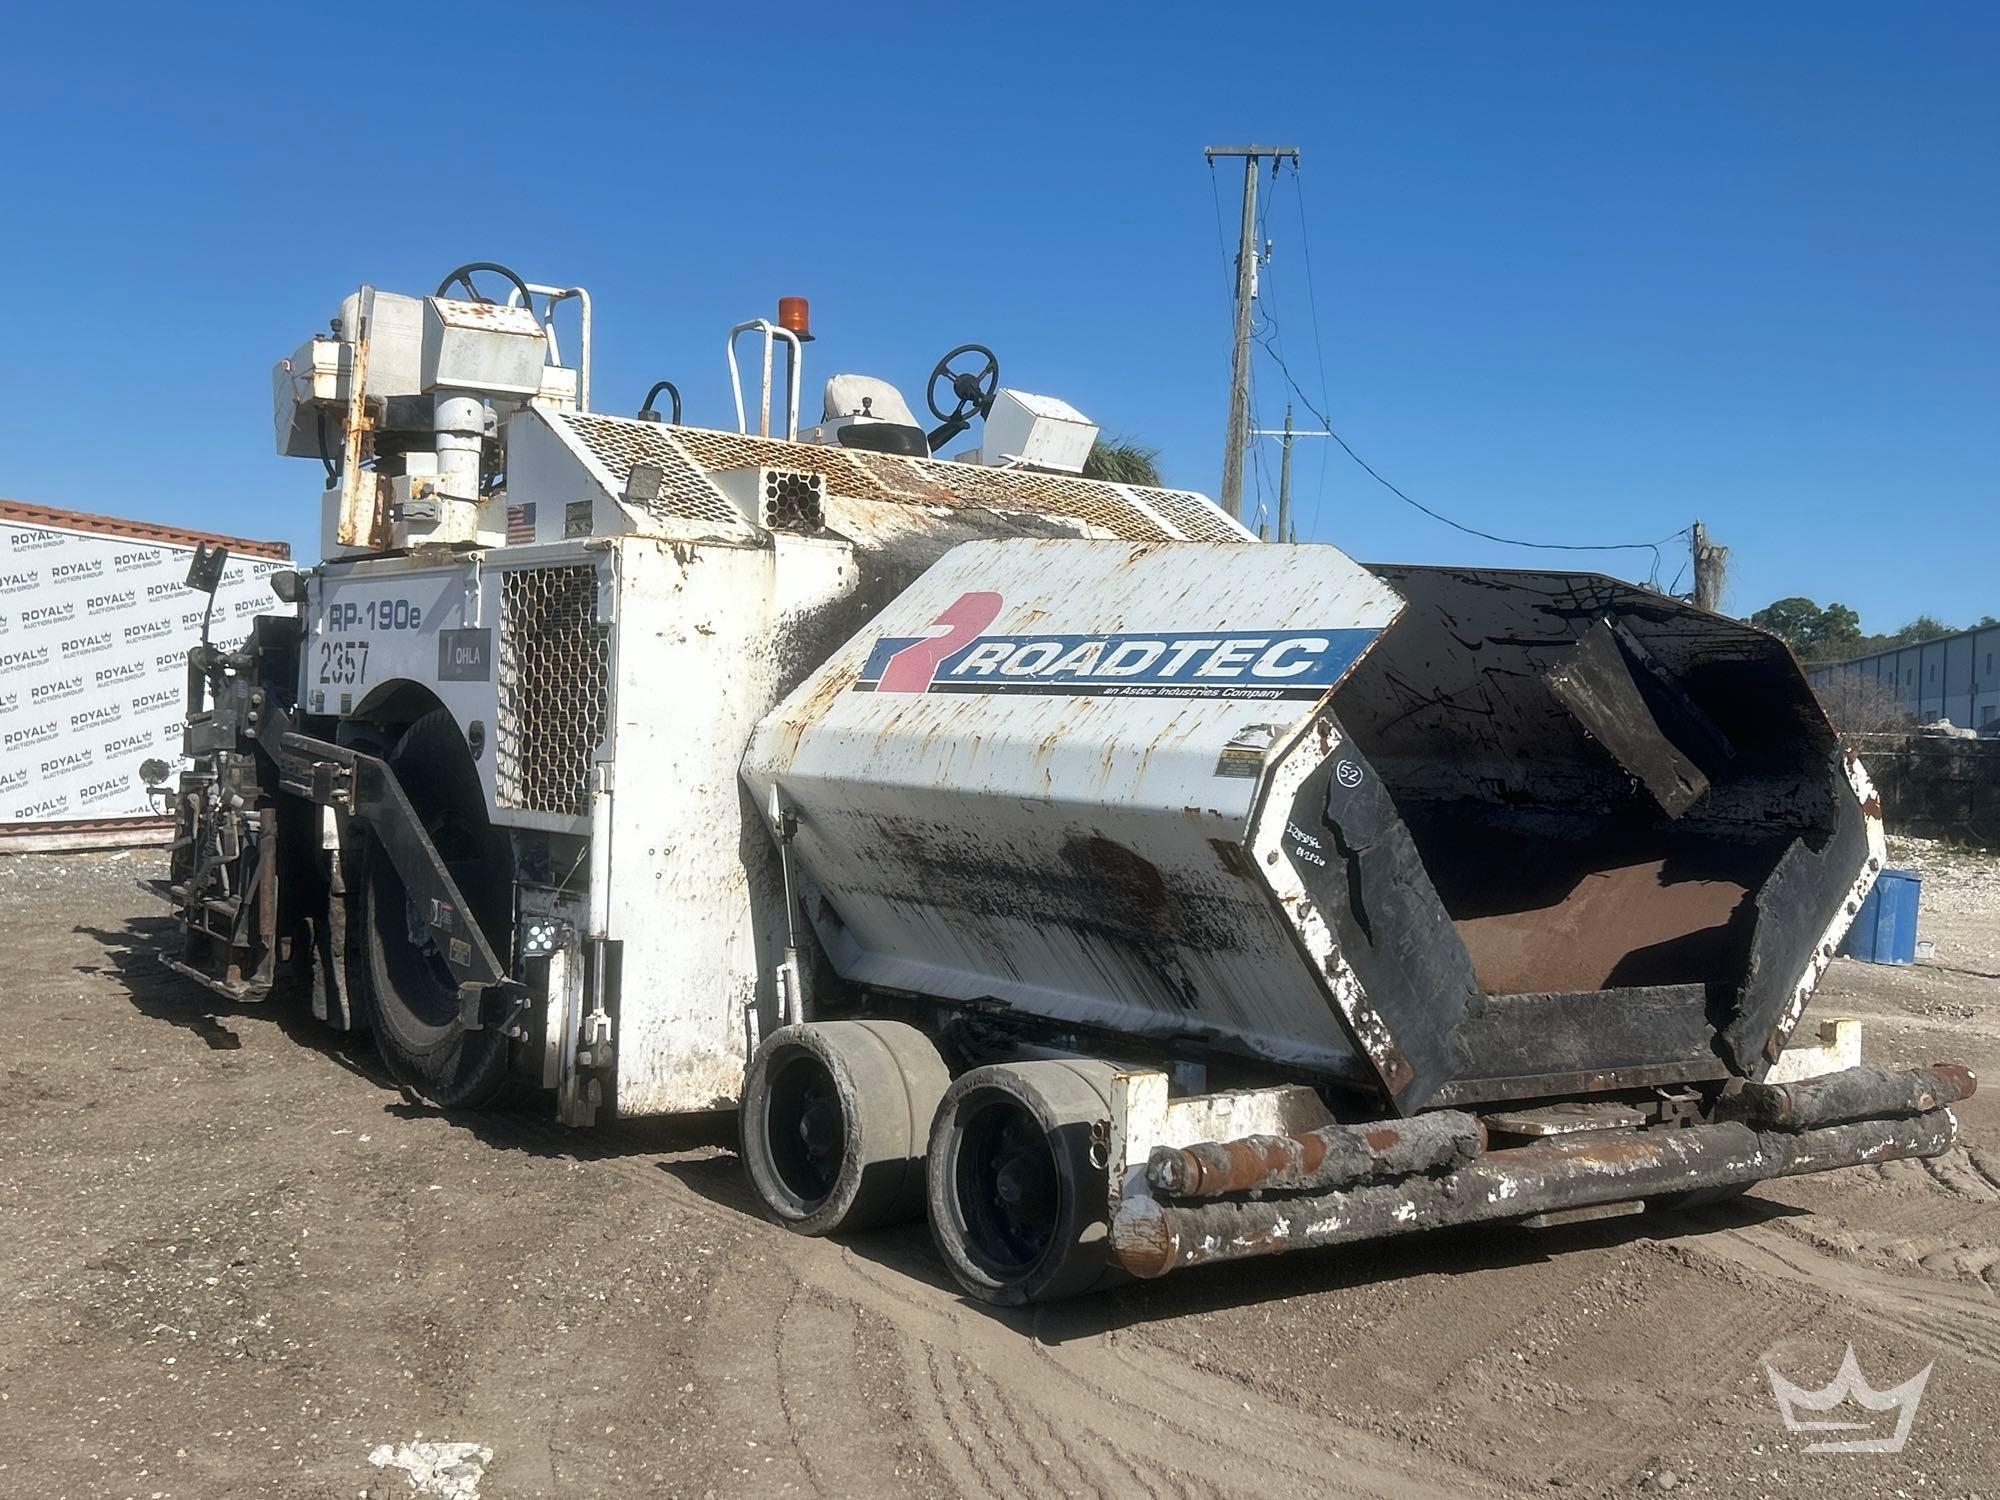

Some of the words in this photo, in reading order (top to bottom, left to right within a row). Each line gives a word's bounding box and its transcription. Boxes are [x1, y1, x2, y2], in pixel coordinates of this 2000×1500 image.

[11, 531, 53, 546] ROYAL
[13, 543, 42, 553] AUCTION
[43, 539, 65, 549] GROUP
[114, 551, 151, 566] ROYAL
[116, 564, 142, 573] AUCTION
[142, 560, 162, 569] GROUP
[52, 562, 93, 578] ROYAL
[54, 575, 82, 585] AUCTION
[82, 570, 104, 580] GROUP
[0, 574, 28, 588] YAL
[17, 582, 40, 592] GROUP
[147, 581, 183, 597] ROYAL
[87, 593, 126, 609] ROYAL
[149, 594, 174, 603] AUCTION
[174, 589, 193, 598] GROUP
[21, 605, 64, 622] ROYAL
[88, 606, 115, 616] AUCTION
[116, 601, 137, 610] GROUP
[235, 598, 266, 613] ROYAL
[237, 609, 258, 618] AUCTION
[258, 605, 275, 614] GROUP
[23, 619, 52, 630] AUCTION
[53, 614, 76, 624] GROUP
[329, 599, 421, 632] RP-190e
[124, 622, 161, 638] ROYAL
[126, 634, 152, 644] AUCTION
[152, 629, 173, 639] GROUP
[61, 635, 102, 652] ROYAL
[63, 649, 91, 660] AUCTION
[91, 643, 113, 653] GROUP
[0, 650, 37, 667] OYAL
[320, 641, 370, 685] 2357
[455, 647, 481, 665] OHLA
[949, 637, 1330, 678] ROADTEC
[0, 664, 26, 675] UCTION
[27, 658, 50, 668] GROUP
[95, 664, 134, 682] ROYAL
[158, 663, 183, 673] AUCTION
[31, 680, 73, 698] ROYAL
[97, 678, 124, 689] AUCTION
[124, 672, 146, 682] GROUP
[33, 694, 62, 705] AUCTION
[62, 687, 84, 698] GROUP
[132, 691, 170, 709] ROYAL
[1103, 687, 1118, 696] an
[1120, 687, 1157, 696] Astec
[1157, 687, 1220, 697] Industries
[1221, 688, 1285, 700] Company
[134, 705, 160, 715] AUCTION
[160, 698, 181, 709] GROUP
[70, 707, 111, 726] ROYAL
[72, 720, 100, 733] AUCTION
[100, 714, 122, 726] GROUP
[4, 725, 47, 745] ROYAL
[6, 740, 36, 752] AUCTION
[36, 733, 59, 743] GROUP
[104, 735, 143, 753] ROYAL
[106, 749, 133, 760] AUCTION
[133, 742, 154, 752] GROUP
[41, 753, 82, 773] ROYAL
[43, 769, 71, 780] AUCTION
[72, 760, 94, 771] GROUP
[1340, 765, 1359, 782] 52
[5, 781, 29, 793] GROUP
[80, 779, 120, 799] ROYAL
[82, 793, 109, 806] AUCTION
[109, 785, 131, 797] GROUP
[15, 800, 57, 819] ROYAL
[46, 806, 70, 819] GROUP
